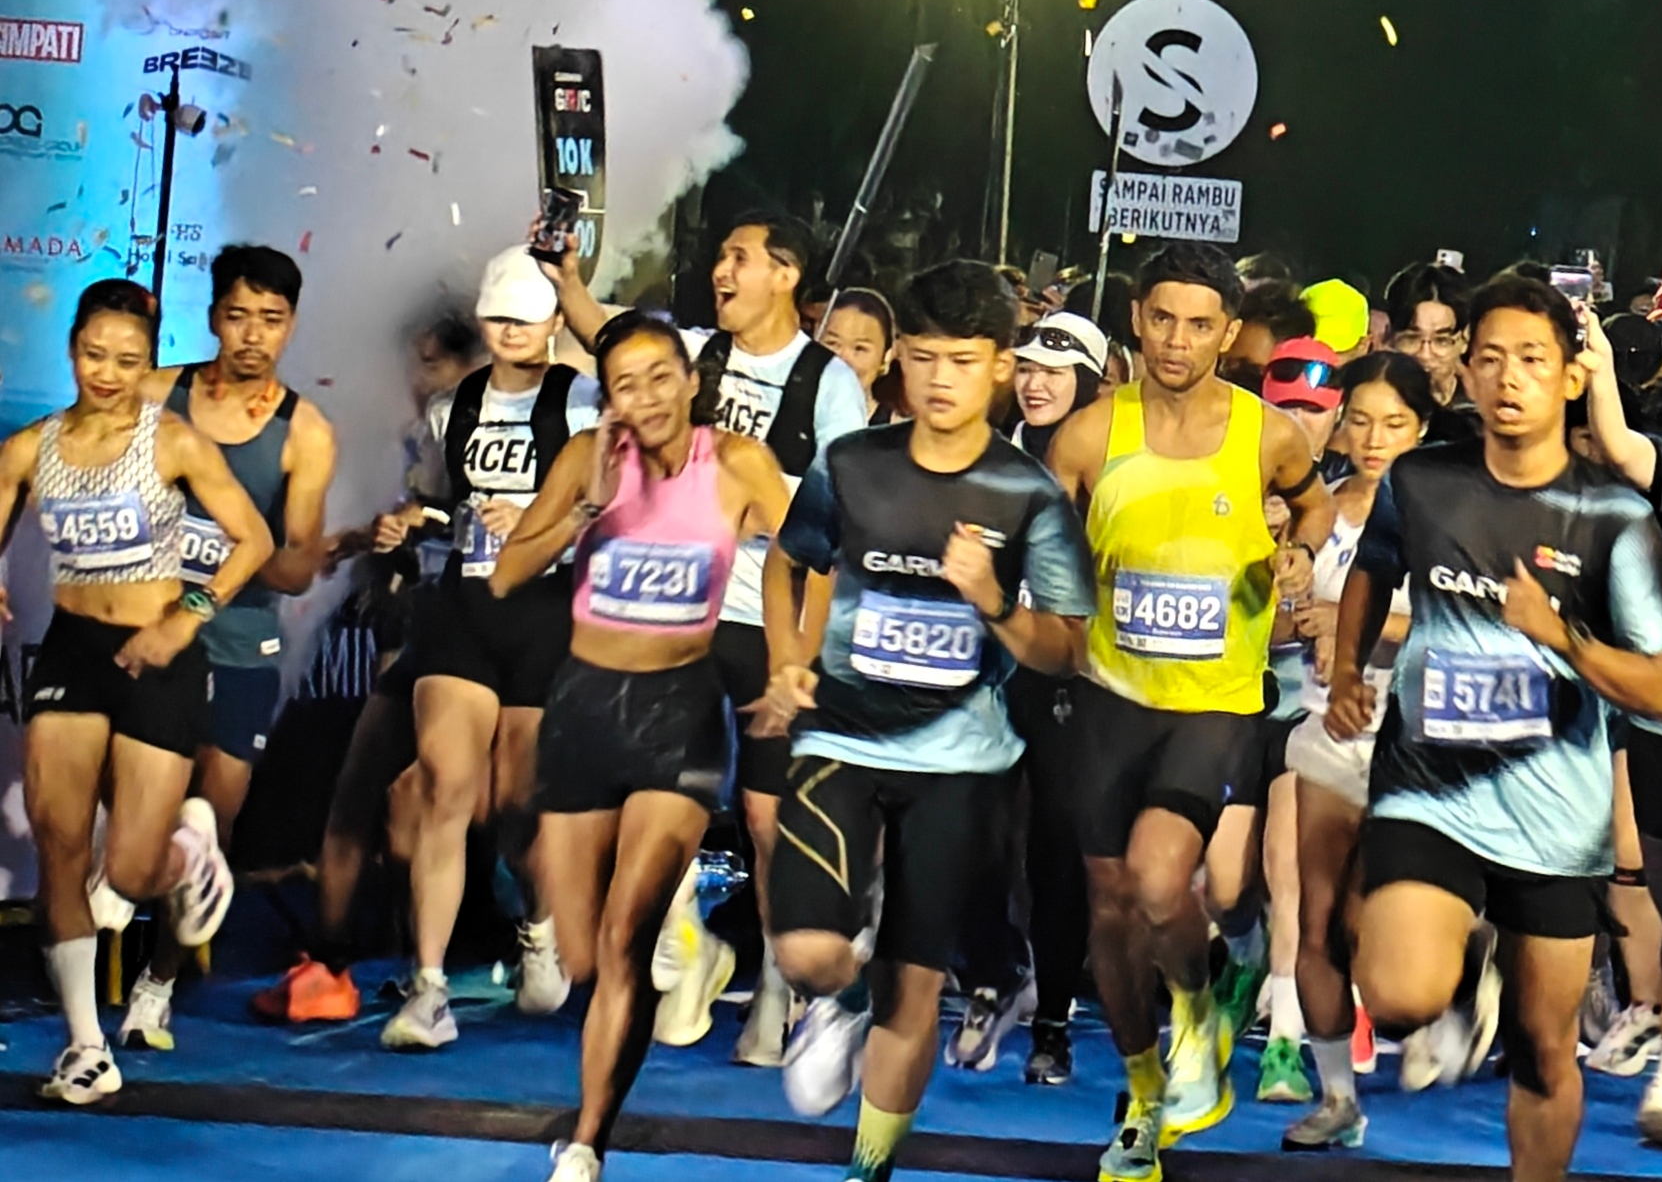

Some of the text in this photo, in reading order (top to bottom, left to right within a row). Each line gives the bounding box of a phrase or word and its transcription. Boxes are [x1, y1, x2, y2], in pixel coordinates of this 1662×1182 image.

[556, 137, 594, 176] 10K
[1172, 184, 1237, 208] RAMBU
[1108, 207, 1222, 233] BERIKUTNYA
[714, 396, 772, 439] ACE
[60, 508, 140, 546] 4559
[181, 532, 230, 566] 06
[1134, 592, 1221, 631] 4682
[880, 617, 979, 661] 5820
[1452, 672, 1534, 712] 5741
